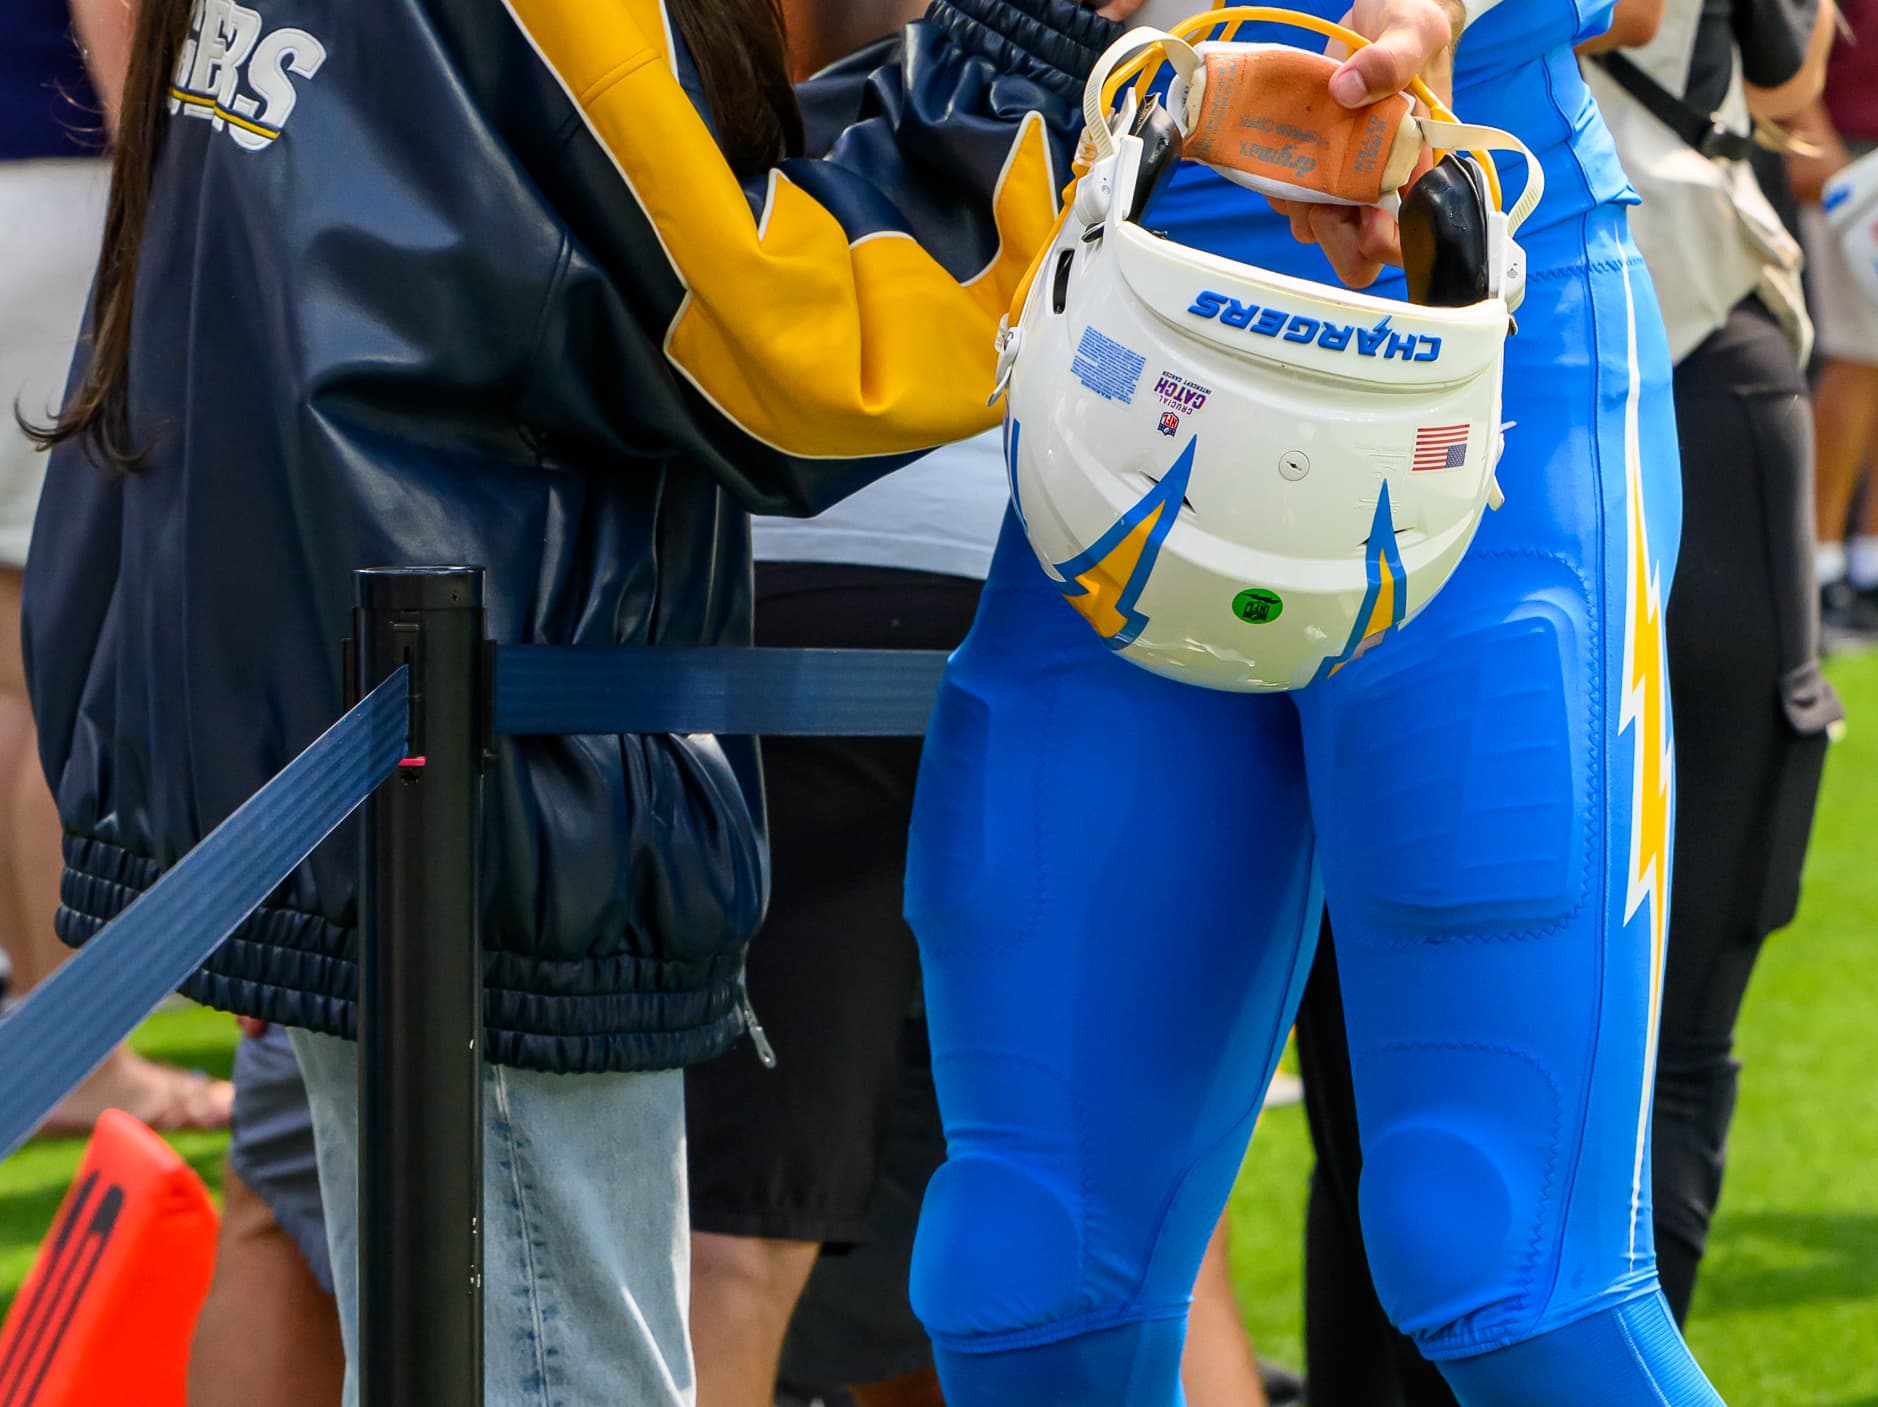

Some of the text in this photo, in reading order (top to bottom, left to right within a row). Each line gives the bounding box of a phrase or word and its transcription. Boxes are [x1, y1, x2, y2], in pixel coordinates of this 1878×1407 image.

[1187, 289, 1443, 363] CHARGERS
[1153, 376, 1207, 410] CATCH
[1161, 370, 1212, 395] INTERCEPT CANCER
[1158, 394, 1194, 416] CRUCIAL
